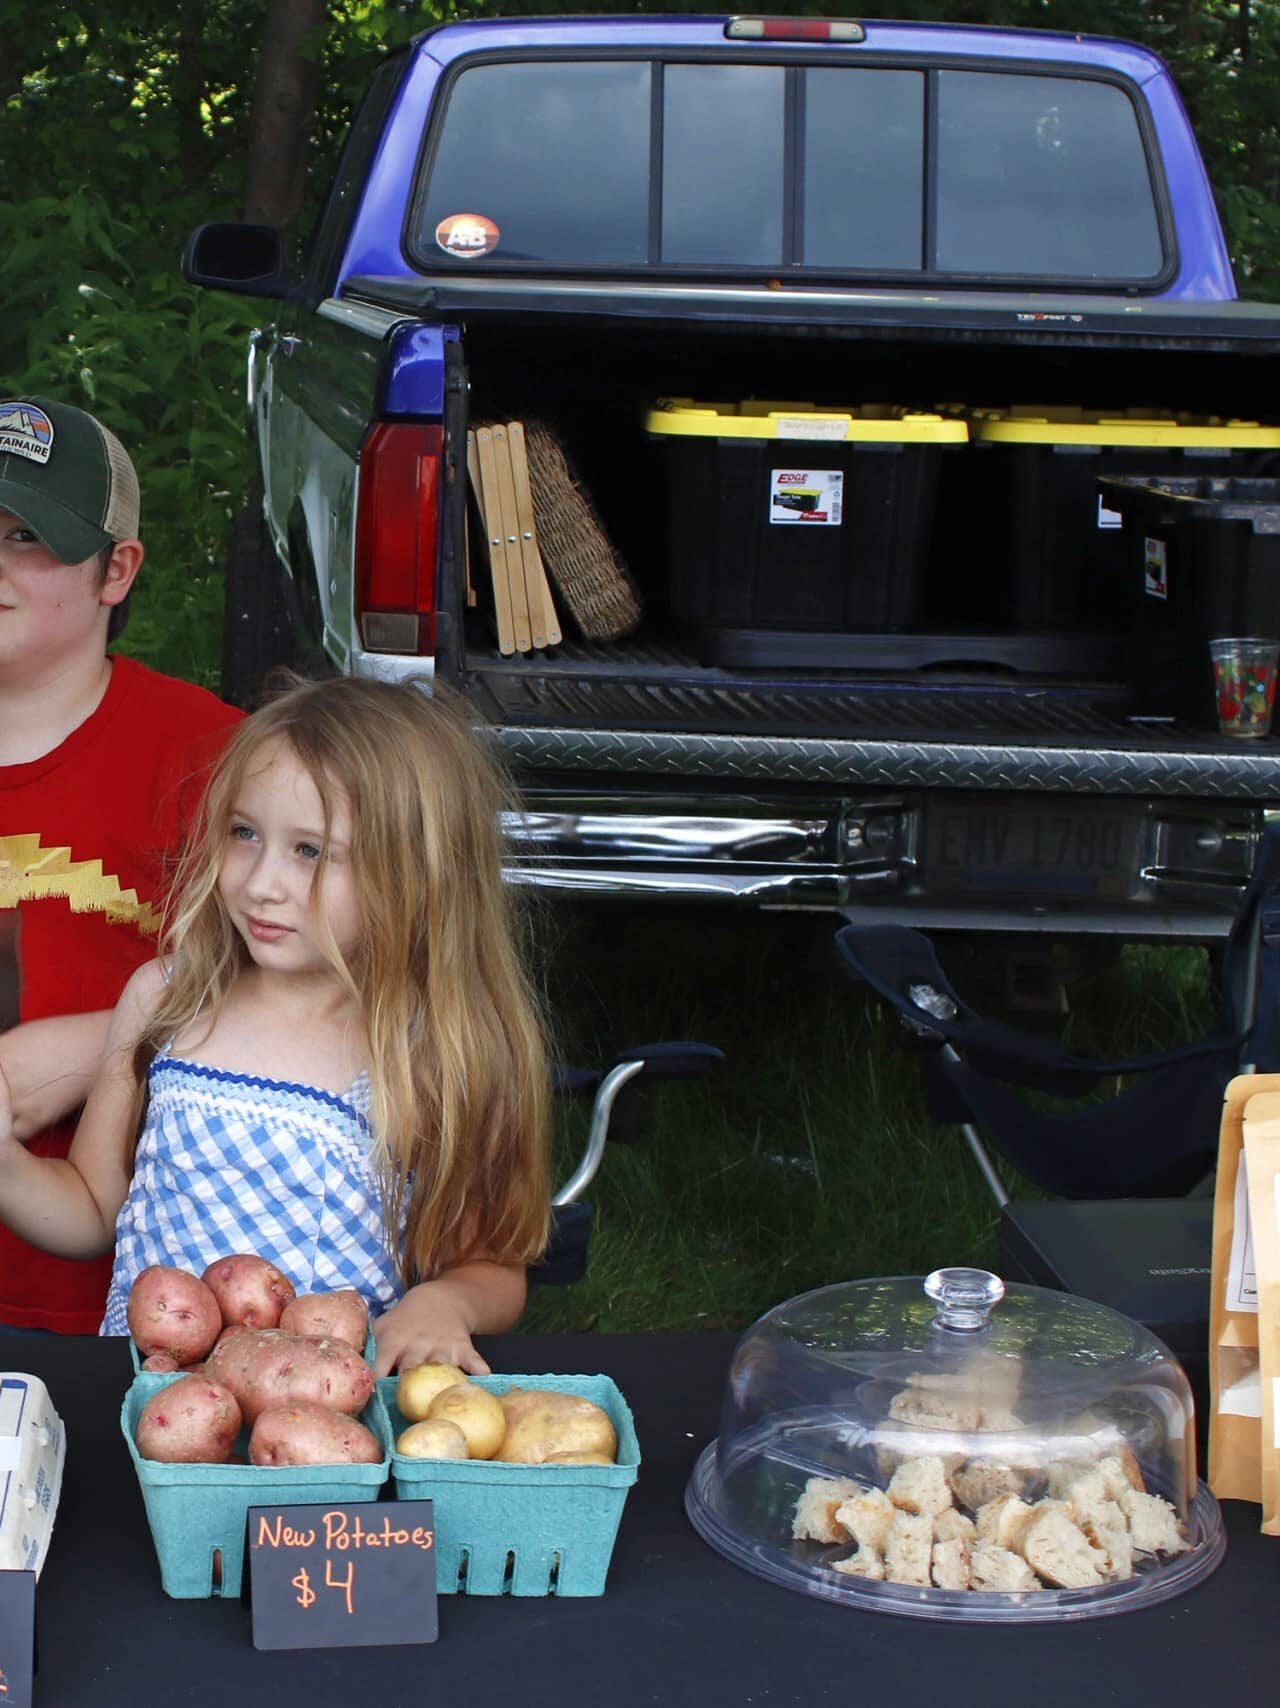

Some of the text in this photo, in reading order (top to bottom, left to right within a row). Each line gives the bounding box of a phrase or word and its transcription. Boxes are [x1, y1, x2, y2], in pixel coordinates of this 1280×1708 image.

[777, 473, 809, 484] EDGE
[257, 1510, 434, 1550] New Potatoes
[291, 1558, 355, 1614] $4
